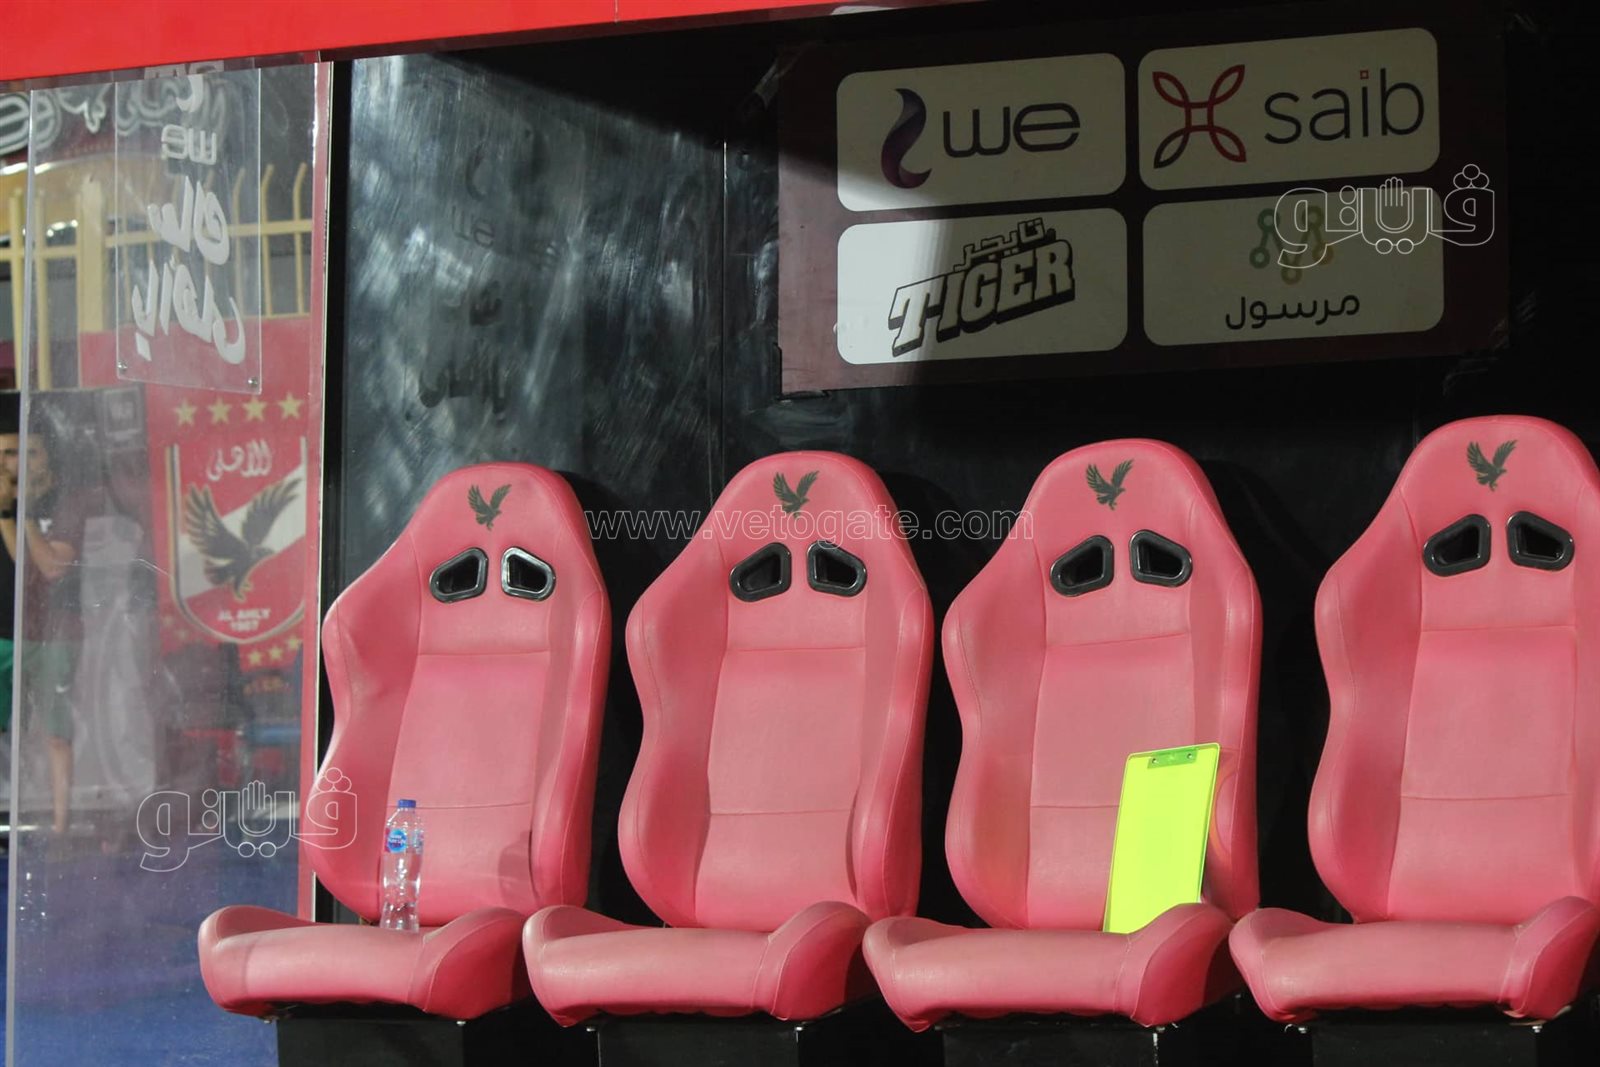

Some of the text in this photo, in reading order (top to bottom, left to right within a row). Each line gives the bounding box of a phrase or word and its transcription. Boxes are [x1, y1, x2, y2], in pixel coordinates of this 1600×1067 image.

[942, 102, 1080, 158] we
[1264, 68, 1425, 144] saib
[952, 217, 1046, 272] تايجر
[888, 238, 1075, 357] TIGER
[1225, 294, 1360, 330] مرسول
